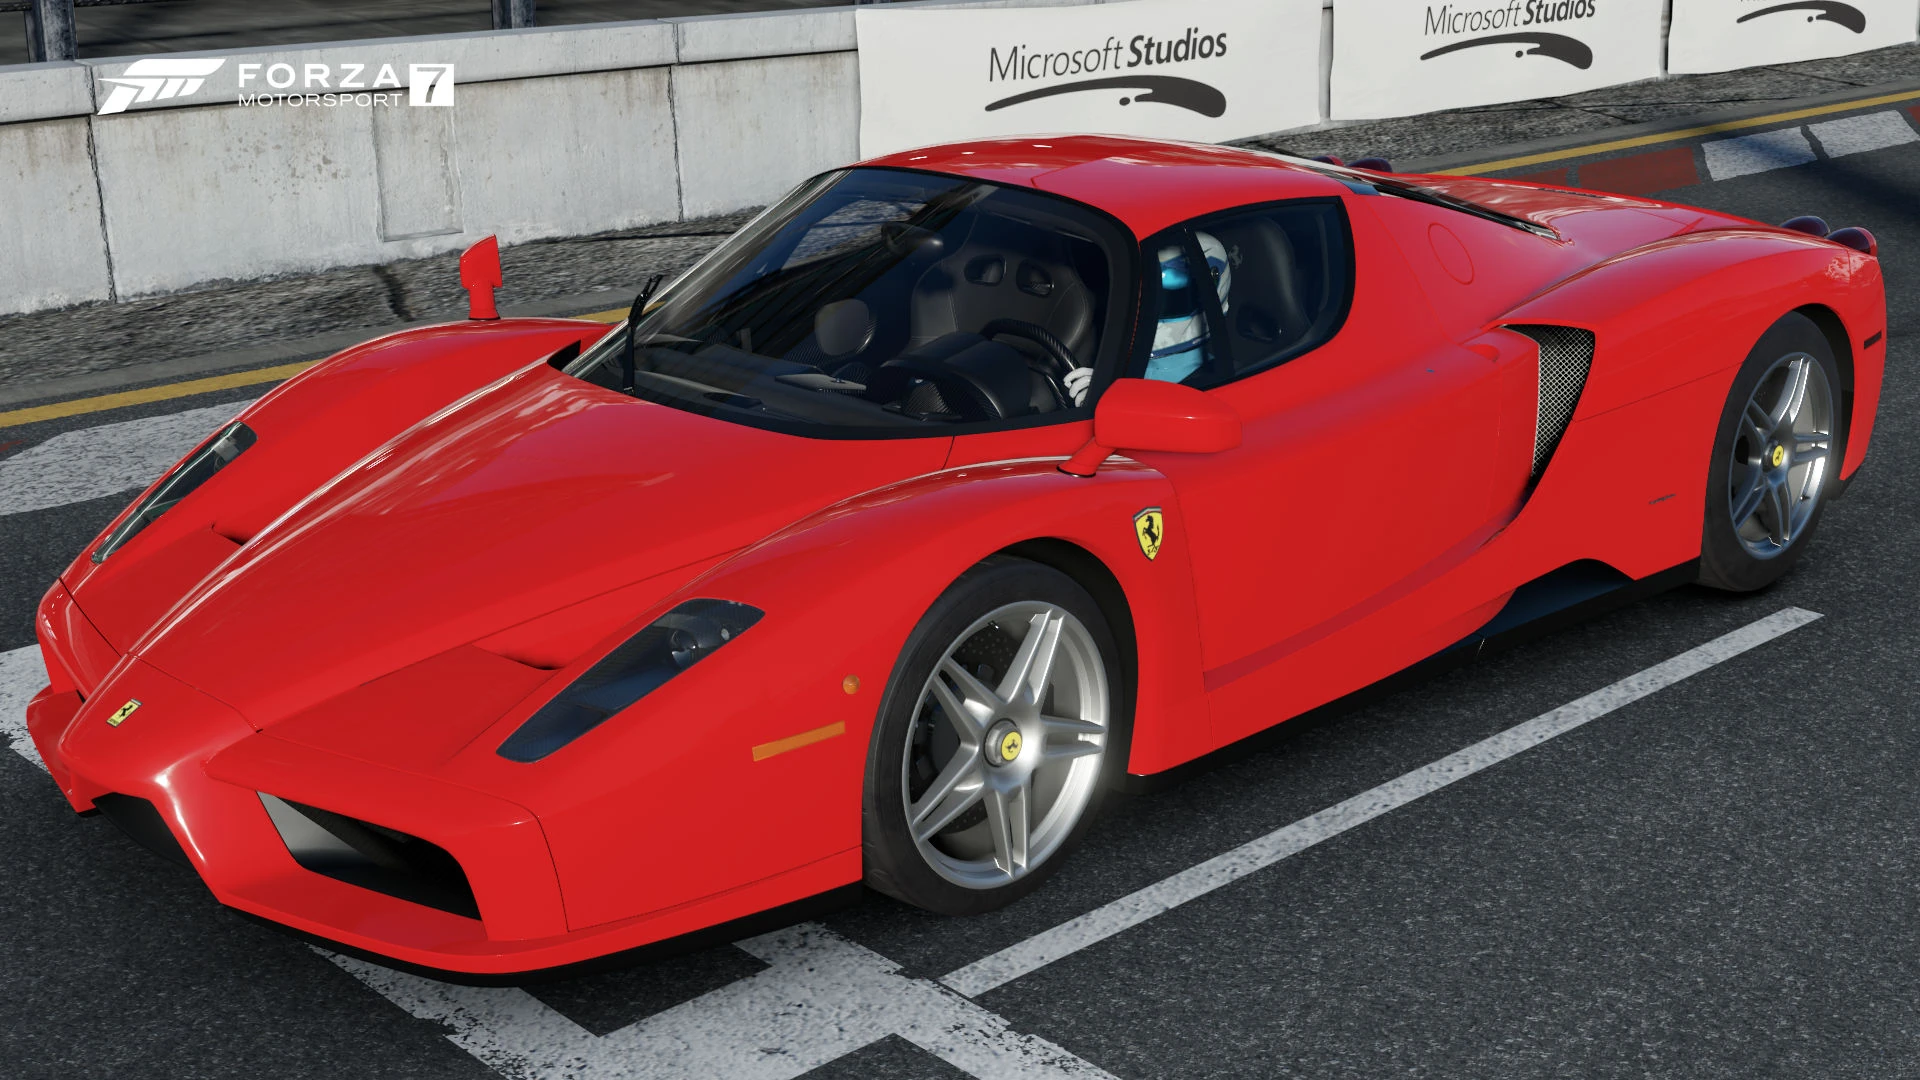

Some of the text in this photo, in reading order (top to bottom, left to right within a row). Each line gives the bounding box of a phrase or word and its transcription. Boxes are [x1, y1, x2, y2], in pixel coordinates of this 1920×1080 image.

[1425, 0, 1596, 35] Microsoft Studios
[989, 27, 1227, 82] Microsoft Studios
